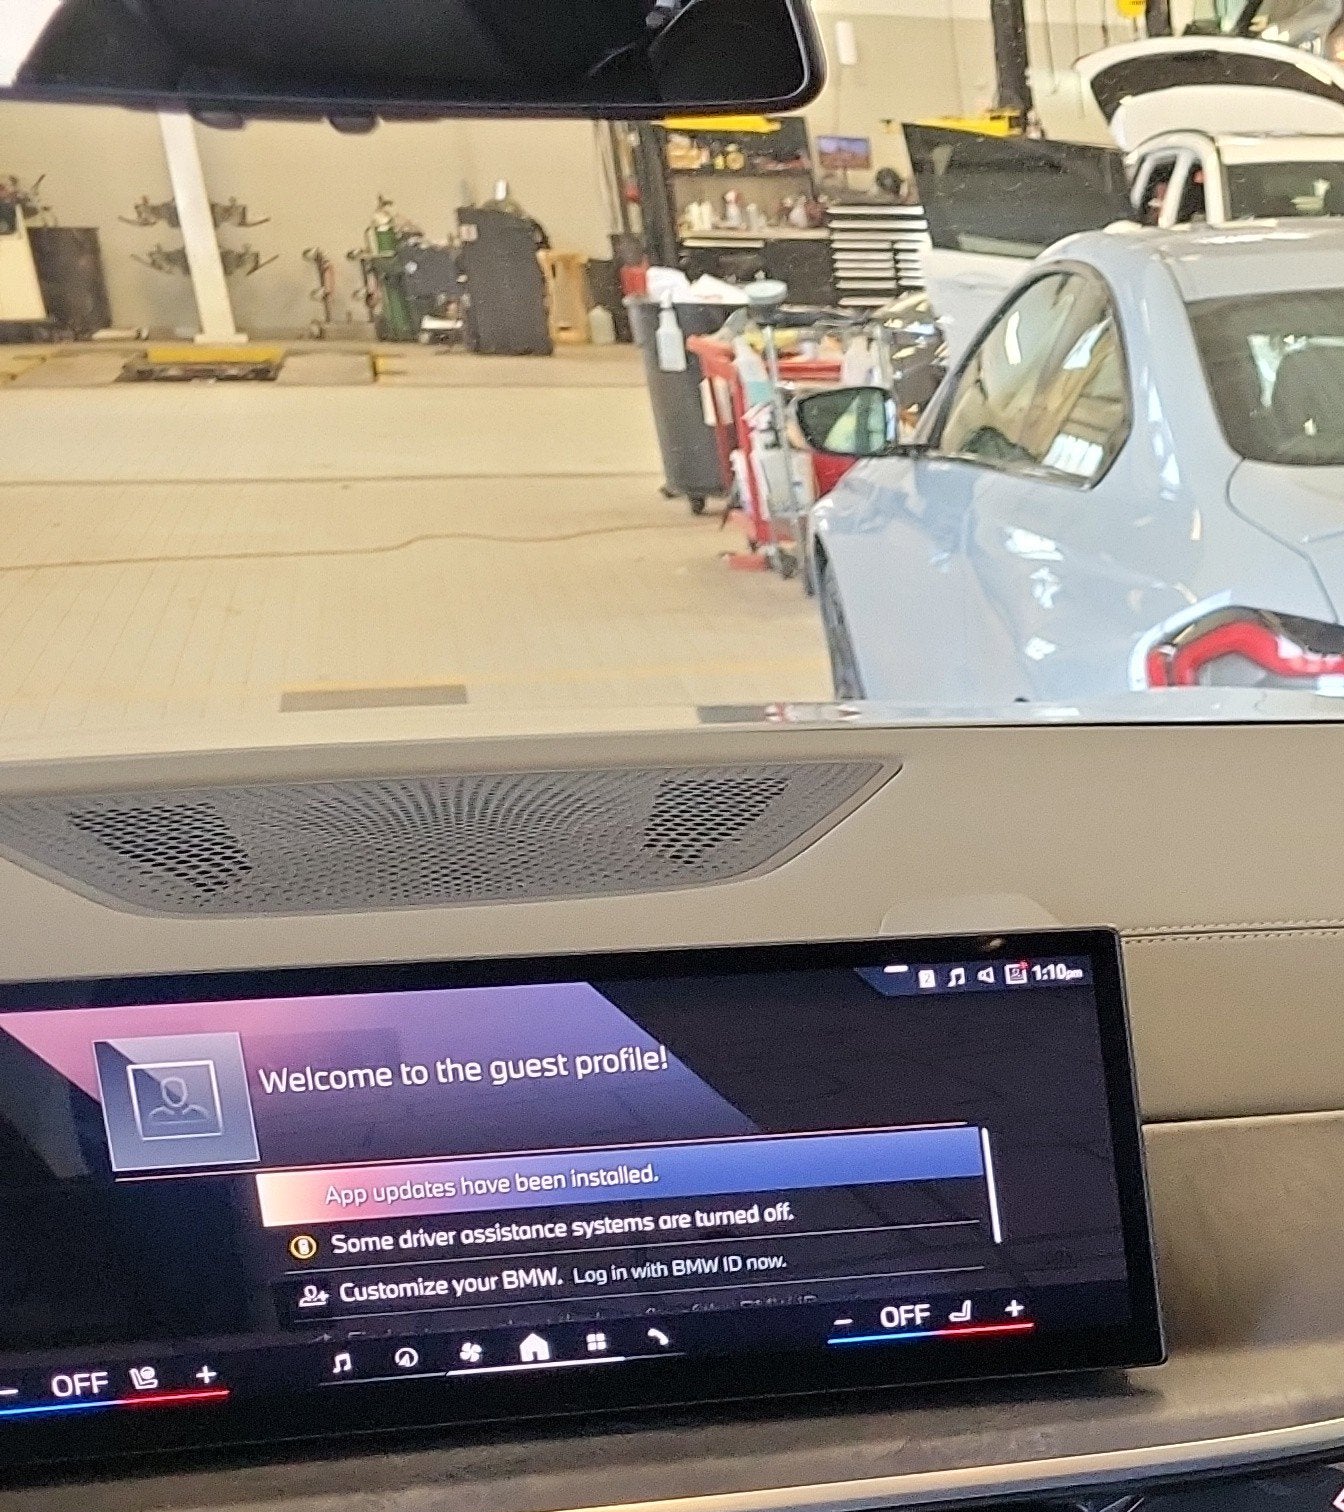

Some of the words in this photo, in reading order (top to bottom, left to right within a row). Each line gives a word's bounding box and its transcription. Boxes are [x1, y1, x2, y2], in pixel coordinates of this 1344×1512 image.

[258, 1066, 393, 1093] Welcome
[400, 1063, 428, 1085] to
[435, 1058, 482, 1083] the
[489, 1054, 569, 1086] guest
[574, 1045, 668, 1080] profile!
[325, 1185, 367, 1206] App
[373, 1180, 456, 1205] updates
[460, 1177, 511, 1196] have
[514, 1173, 566, 1191] been
[571, 1164, 660, 1187] installed.
[331, 1233, 394, 1254] Some
[399, 1228, 456, 1249] driver
[460, 1222, 567, 1245] assistance
[571, 1215, 655, 1239] systems
[659, 1213, 691, 1231] are
[695, 1204, 760, 1228] turned
[763, 1201, 795, 1223] off.
[340, 1278, 449, 1303] Customize
[452, 1276, 500, 1297] your
[502, 1267, 563, 1290] BMW.
[573, 1267, 608, 1286] Log
[611, 1264, 628, 1281] in
[631, 1261, 668, 1280] with
[672, 1256, 720, 1276] BMW
[723, 1255, 742, 1273] ID
[746, 1254, 788, 1271] now.
[879, 1303, 931, 1329] OFF
[51, 1370, 109, 1398] OFF
